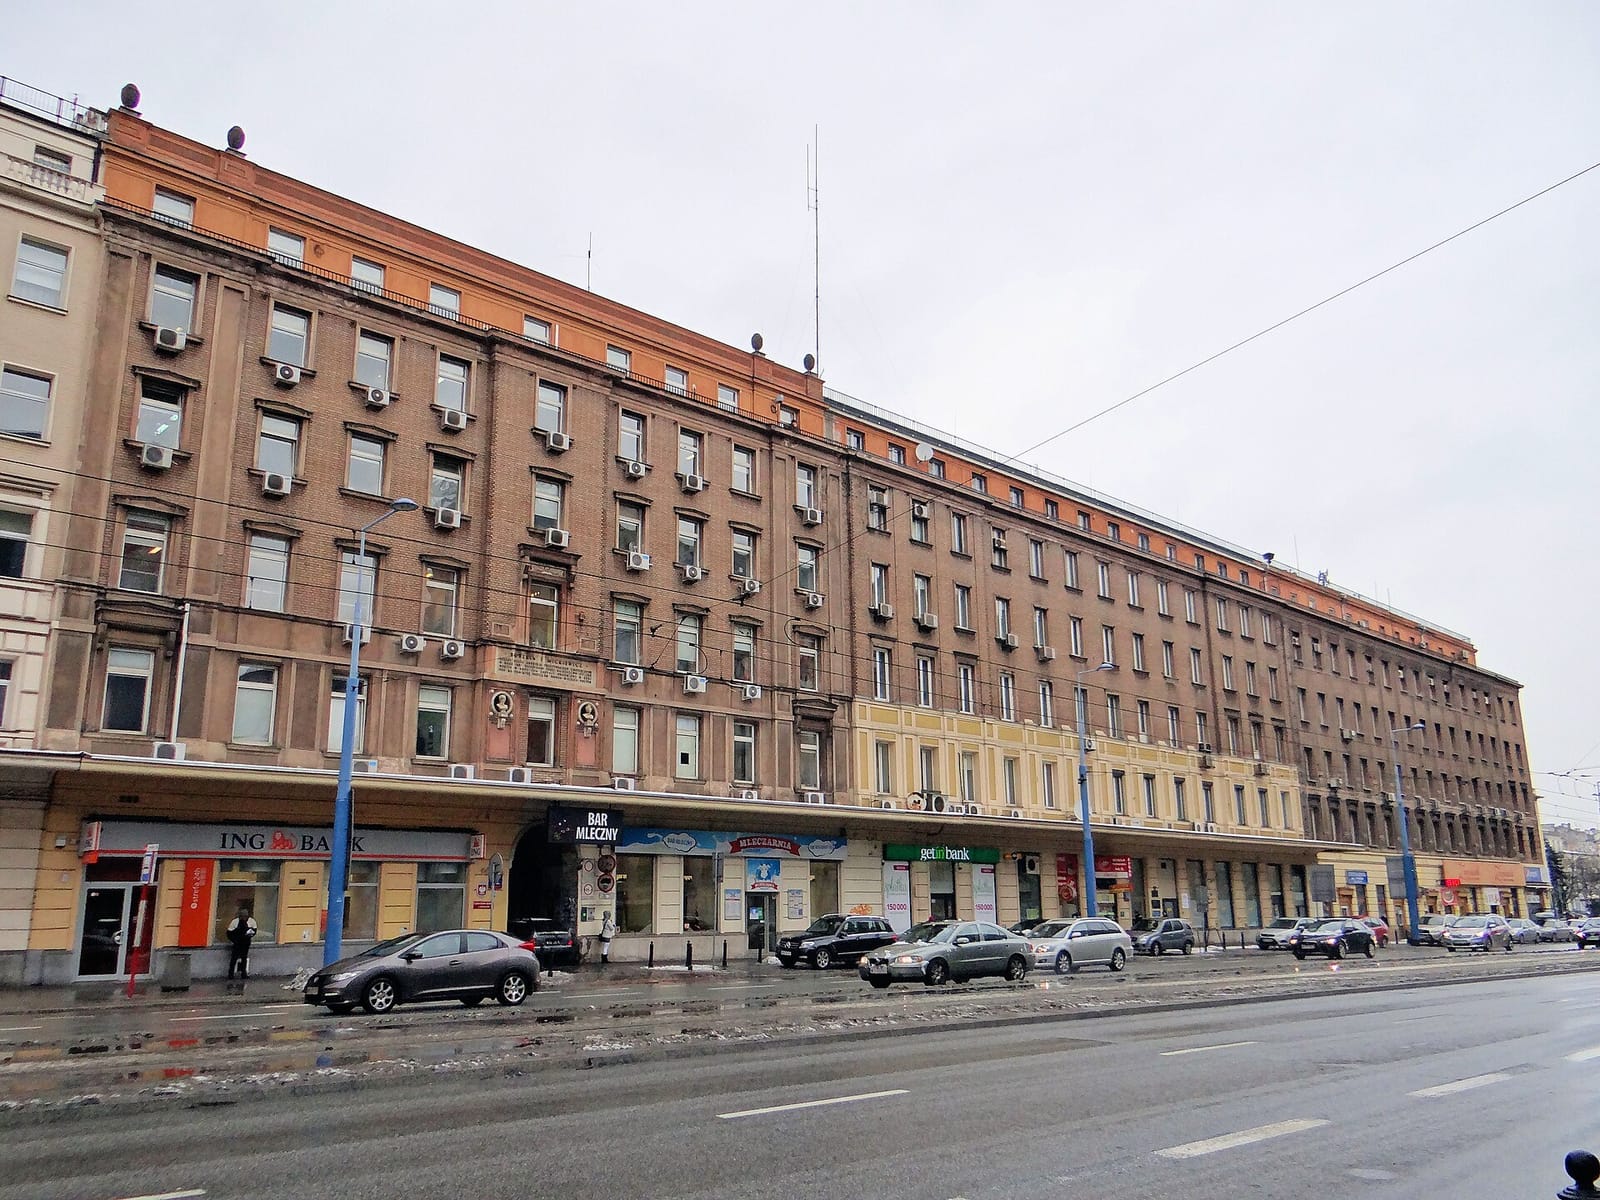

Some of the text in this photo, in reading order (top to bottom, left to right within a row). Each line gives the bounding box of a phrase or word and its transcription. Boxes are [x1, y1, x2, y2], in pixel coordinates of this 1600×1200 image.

[588, 812, 608, 827] BAR
[576, 826, 618, 841] MLECZNY
[220, 832, 365, 852] ING BAK
[739, 837, 792, 850] MLECZARNIA
